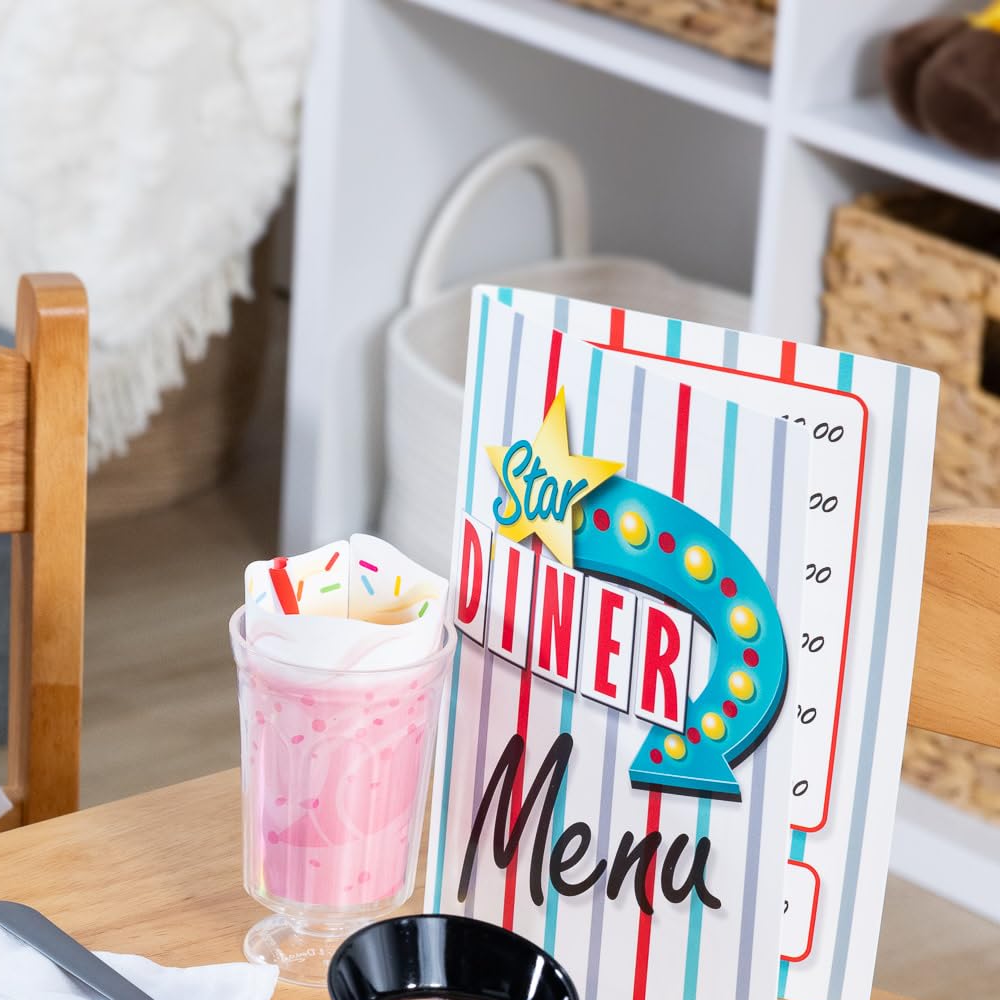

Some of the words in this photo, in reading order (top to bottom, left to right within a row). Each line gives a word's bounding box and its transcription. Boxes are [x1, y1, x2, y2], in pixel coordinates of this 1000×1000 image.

[493, 440, 588, 525] Star
[457, 518, 682, 723] DINER
[457, 733, 722, 915] Menu
